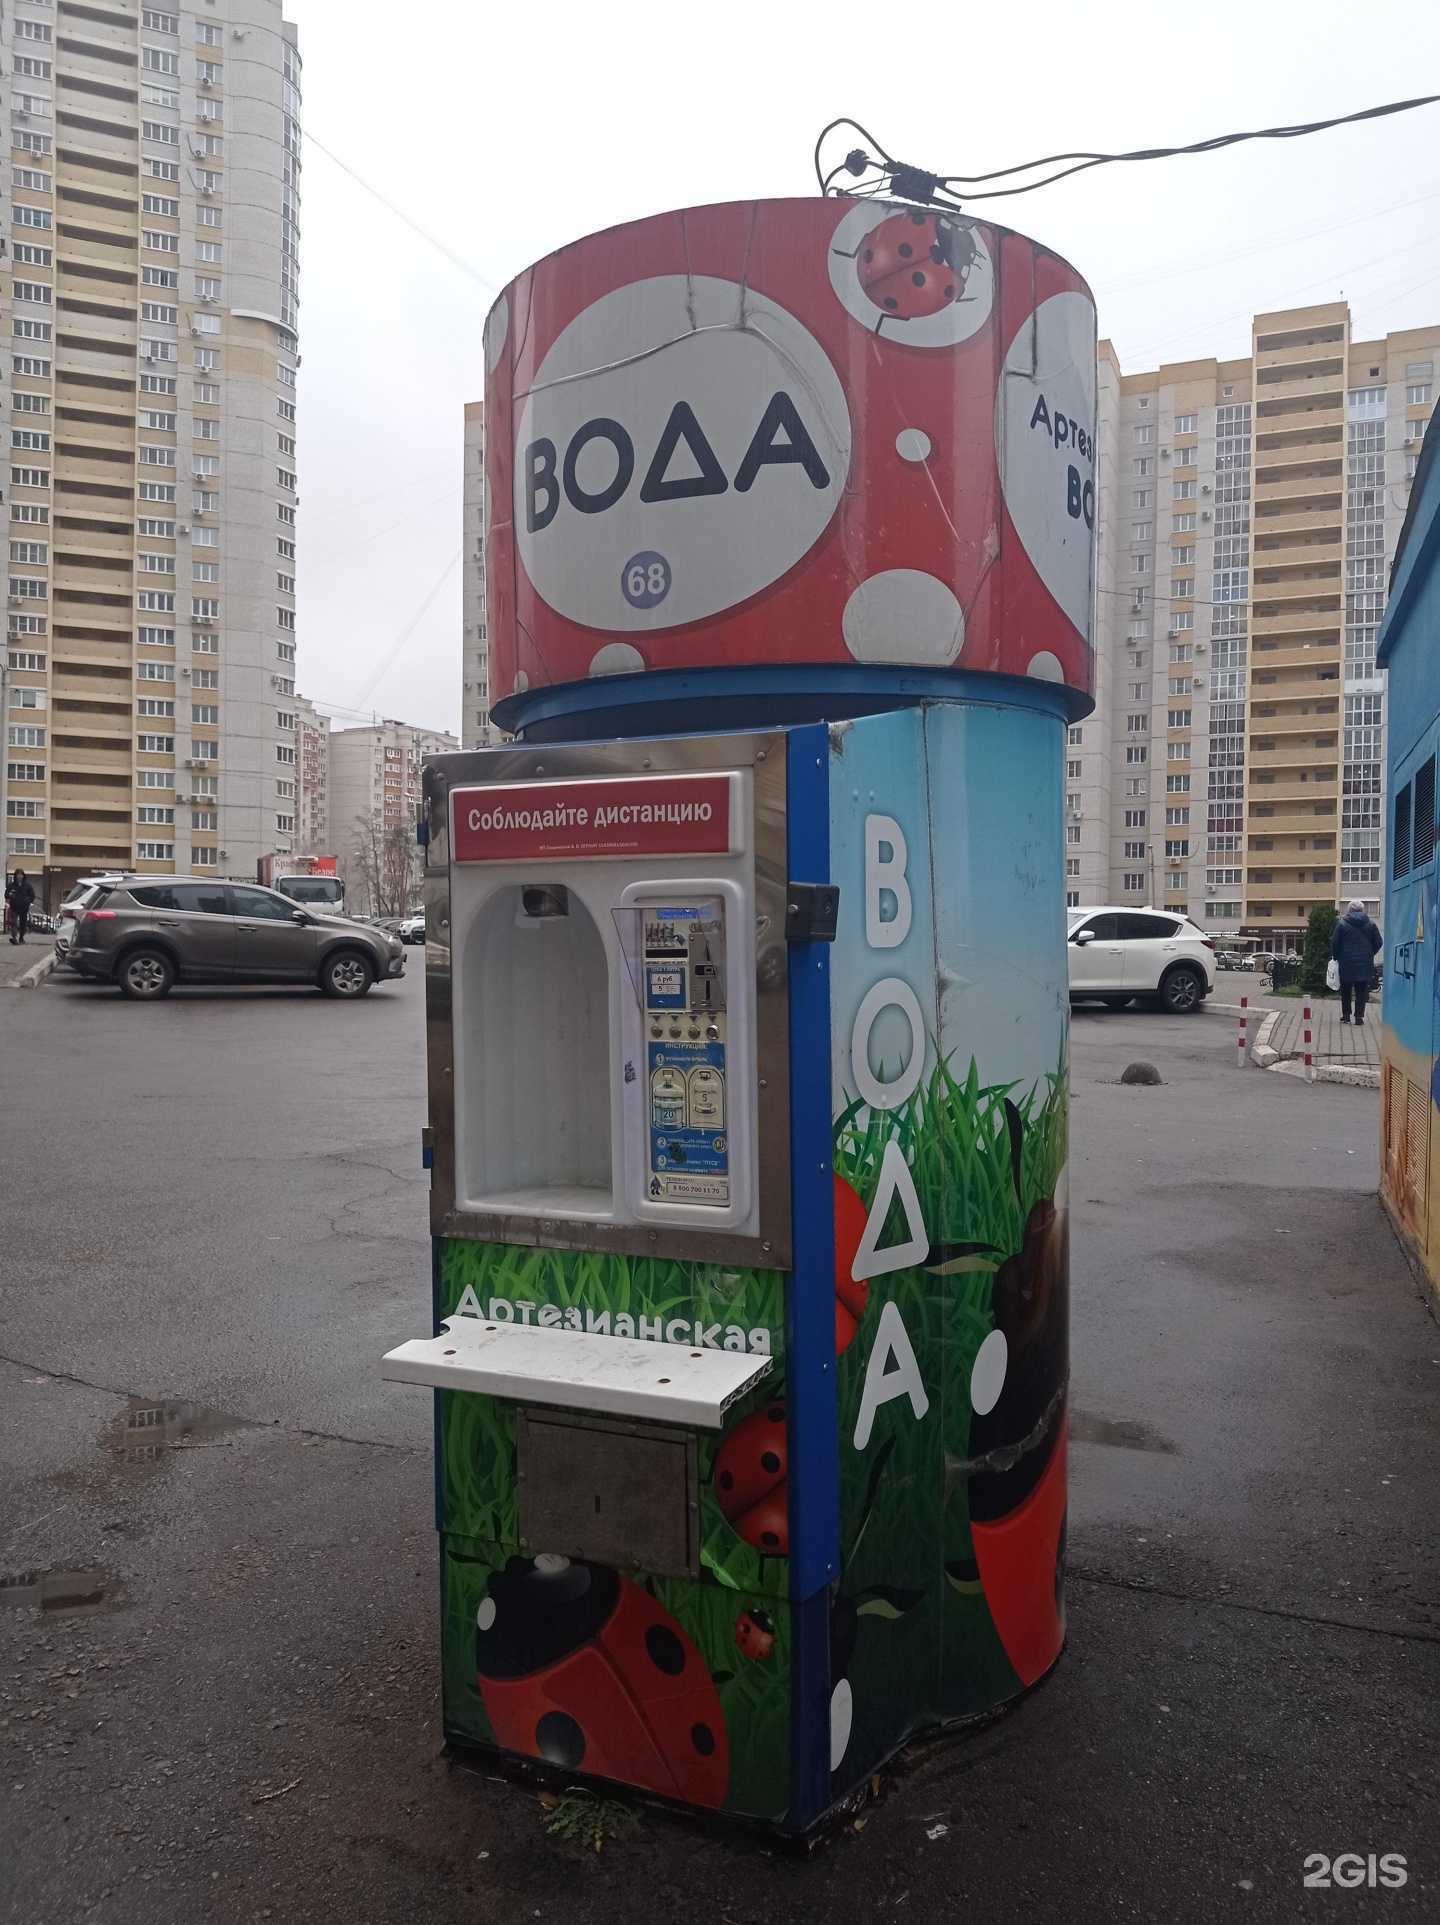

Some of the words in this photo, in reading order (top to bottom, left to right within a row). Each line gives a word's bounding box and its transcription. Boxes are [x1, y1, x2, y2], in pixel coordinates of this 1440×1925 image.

[525, 391, 830, 533] ВОДА
[627, 563, 666, 597] 68
[468, 802, 588, 831] Соблюдайте
[594, 802, 712, 828] дистанцию
[852, 814, 930, 1450] ВОДА
[455, 1283, 771, 1356] Артезианская
